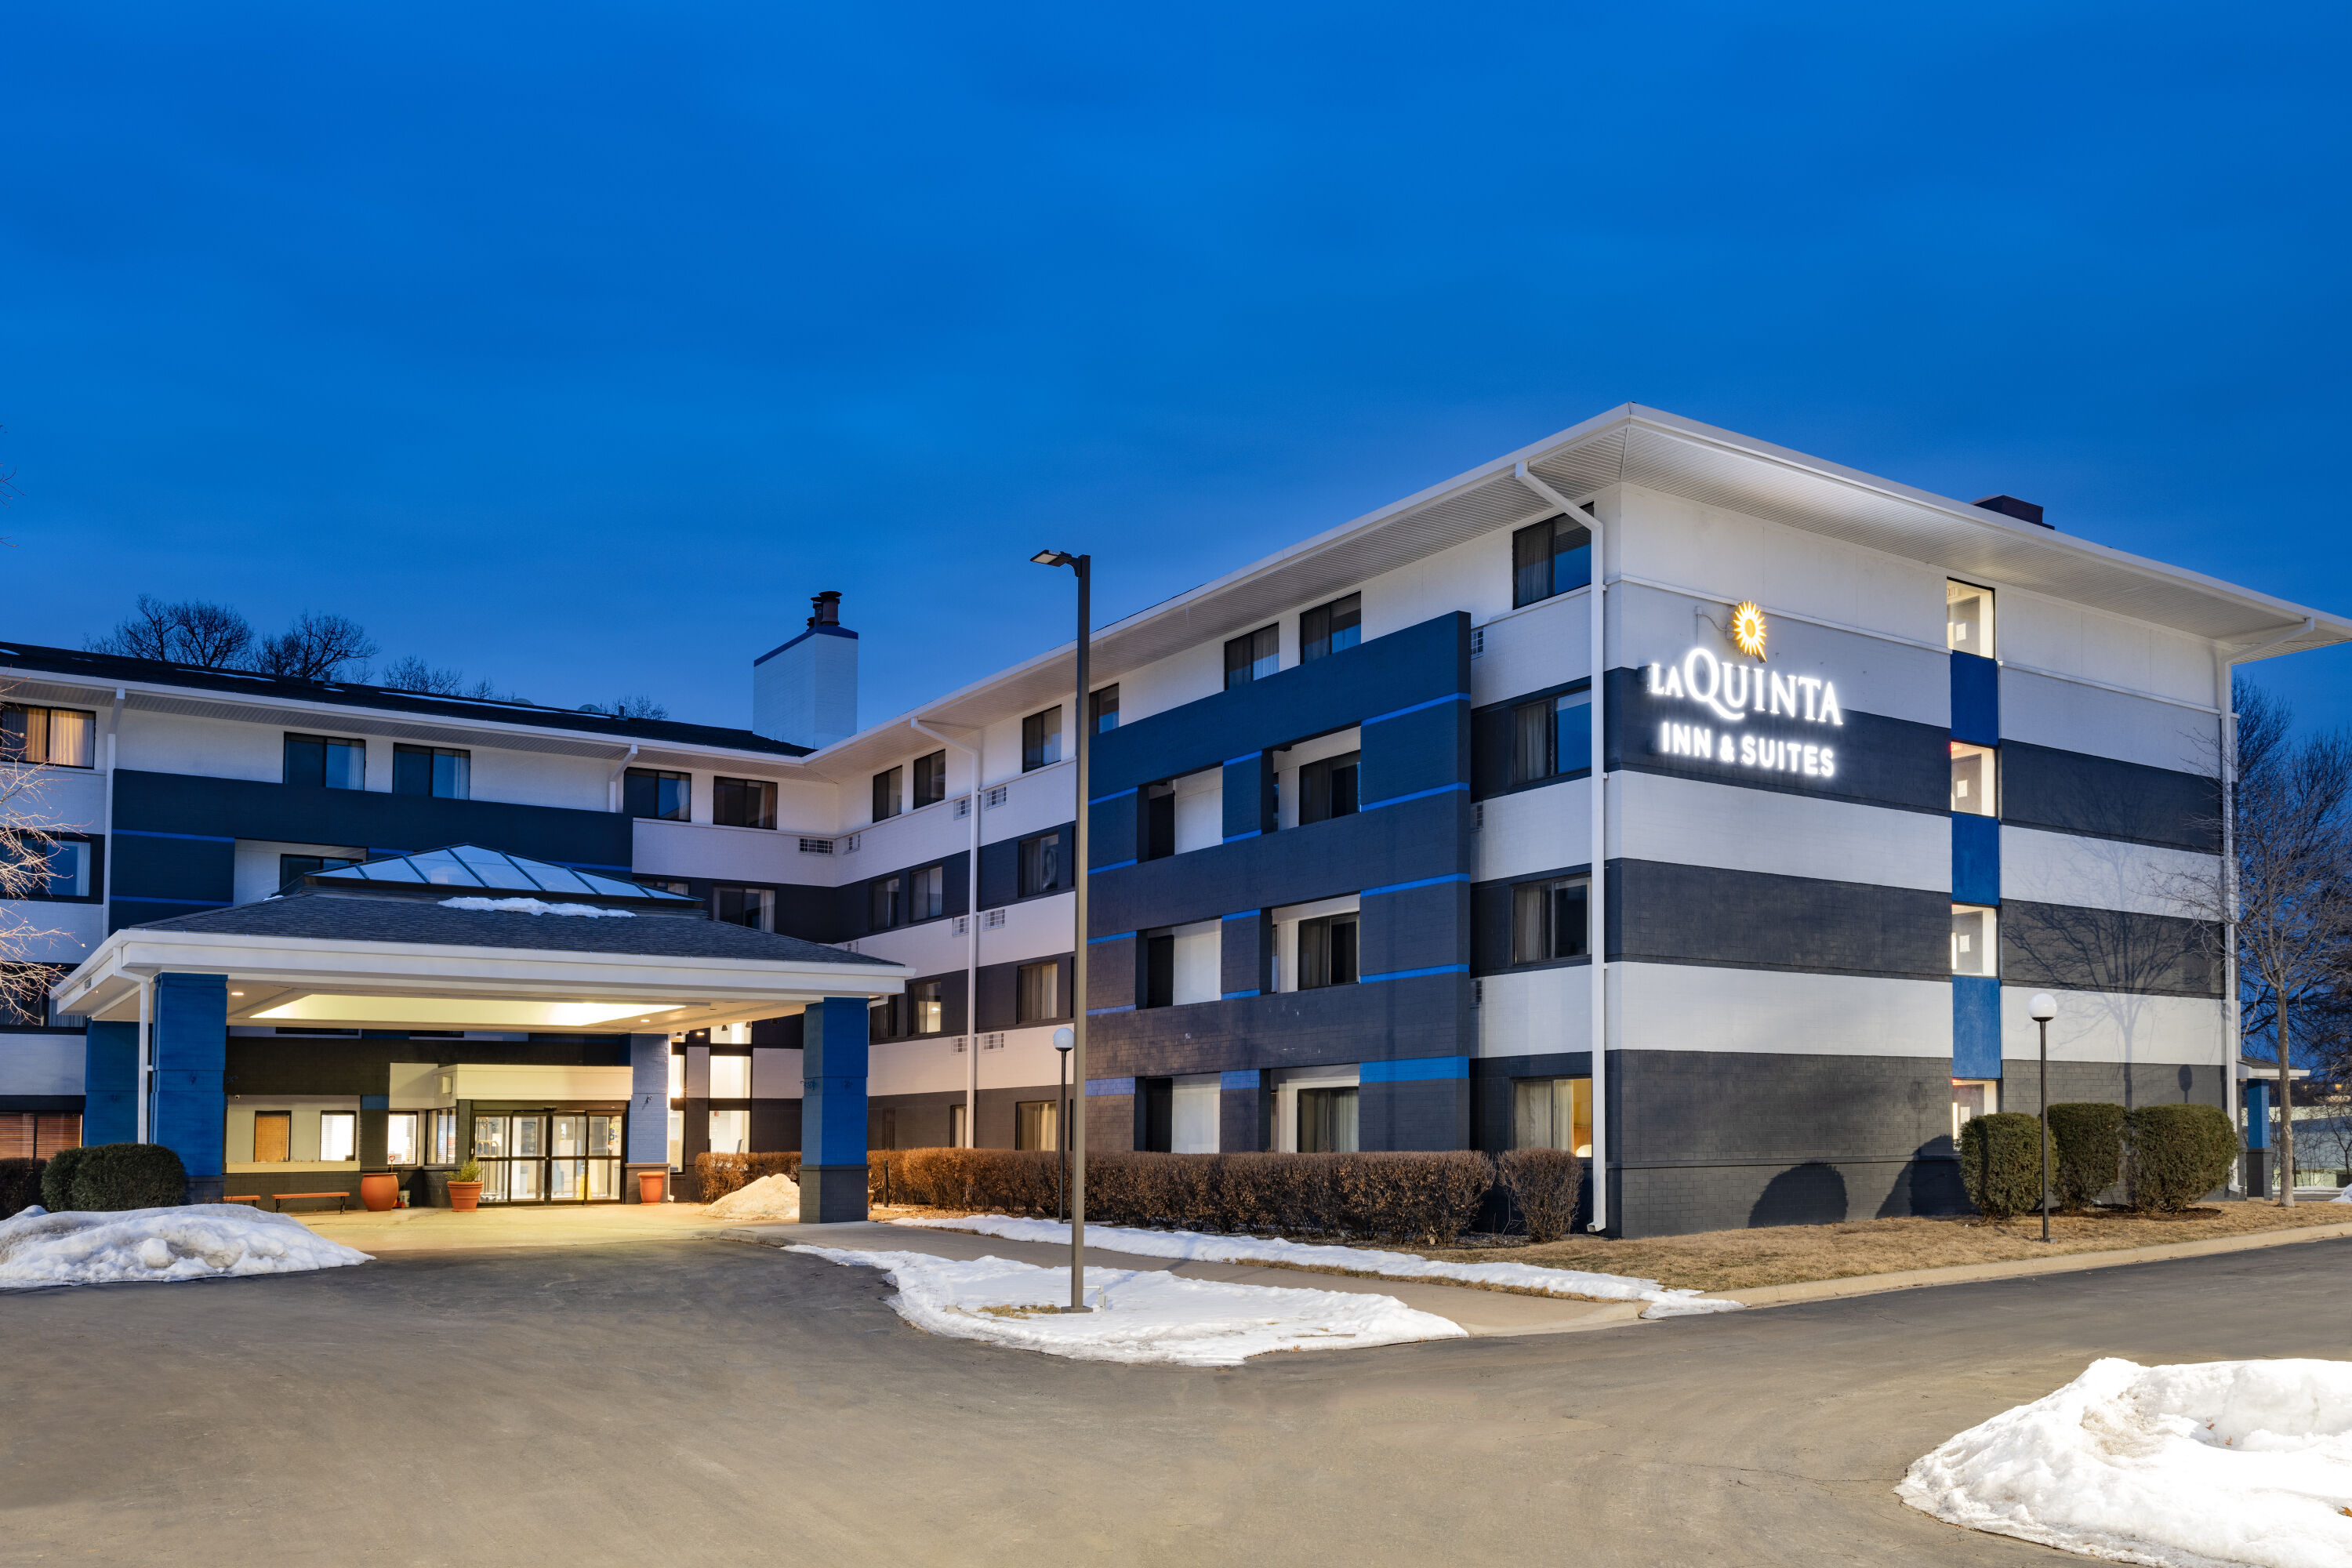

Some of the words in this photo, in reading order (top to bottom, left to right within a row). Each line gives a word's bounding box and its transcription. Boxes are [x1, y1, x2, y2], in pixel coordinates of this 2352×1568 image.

[1650, 662, 1684, 697] LA
[1685, 648, 1843, 725] QUINTA
[1661, 722, 1711, 758] INN
[1720, 735, 1734, 762] &
[1741, 735, 1835, 777] SUITES
